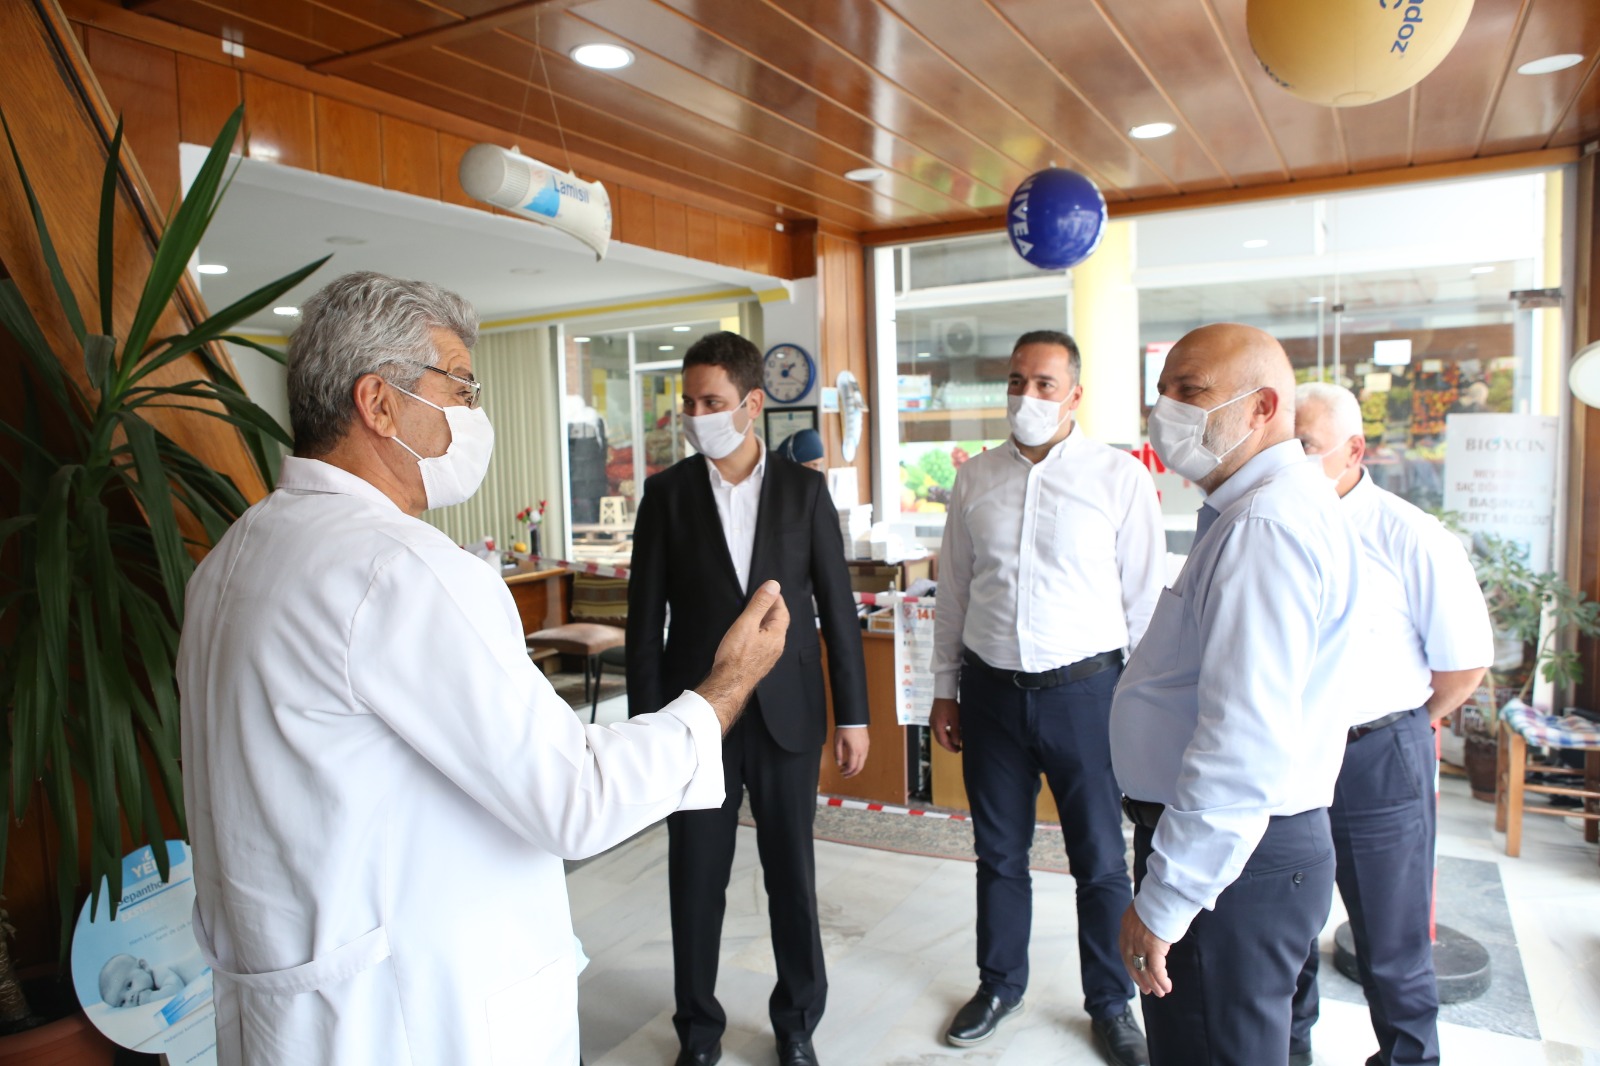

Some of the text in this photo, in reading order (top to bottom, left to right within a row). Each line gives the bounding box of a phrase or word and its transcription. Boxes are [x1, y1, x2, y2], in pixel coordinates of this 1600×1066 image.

[1390, 0, 1424, 54] doz
[552, 175, 590, 204] Lamisil
[118, 880, 167, 906] epantho
